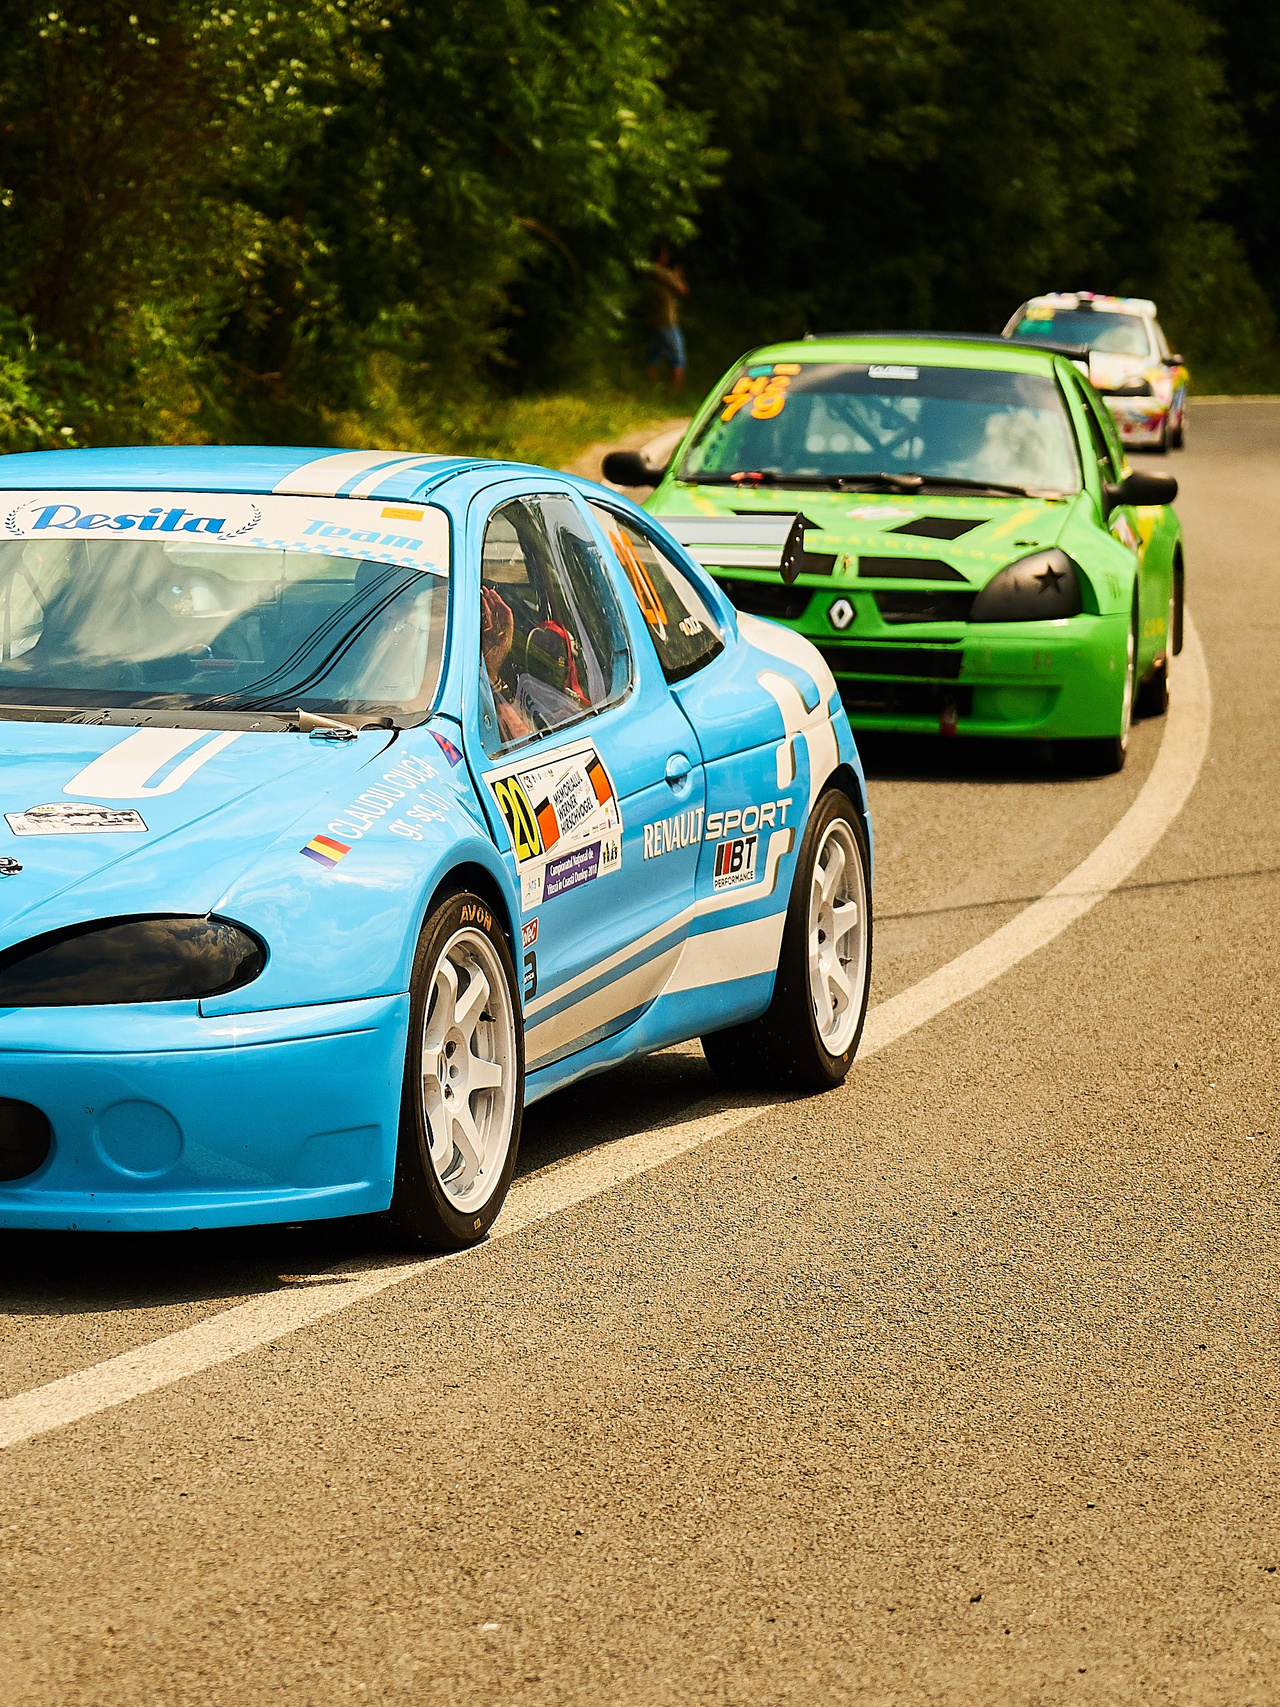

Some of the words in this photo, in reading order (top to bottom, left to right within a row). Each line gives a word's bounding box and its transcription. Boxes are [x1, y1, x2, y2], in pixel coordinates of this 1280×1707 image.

[720, 392, 785, 422] 79
[302, 518, 424, 551] Team
[327, 782, 407, 840] CLAUDIU
[494, 776, 540, 861] 20
[704, 797, 793, 842] SPORT
[643, 806, 705, 861] RENAULT
[714, 870, 754, 889] PERFORMANCE
[459, 904, 493, 932] AVON
